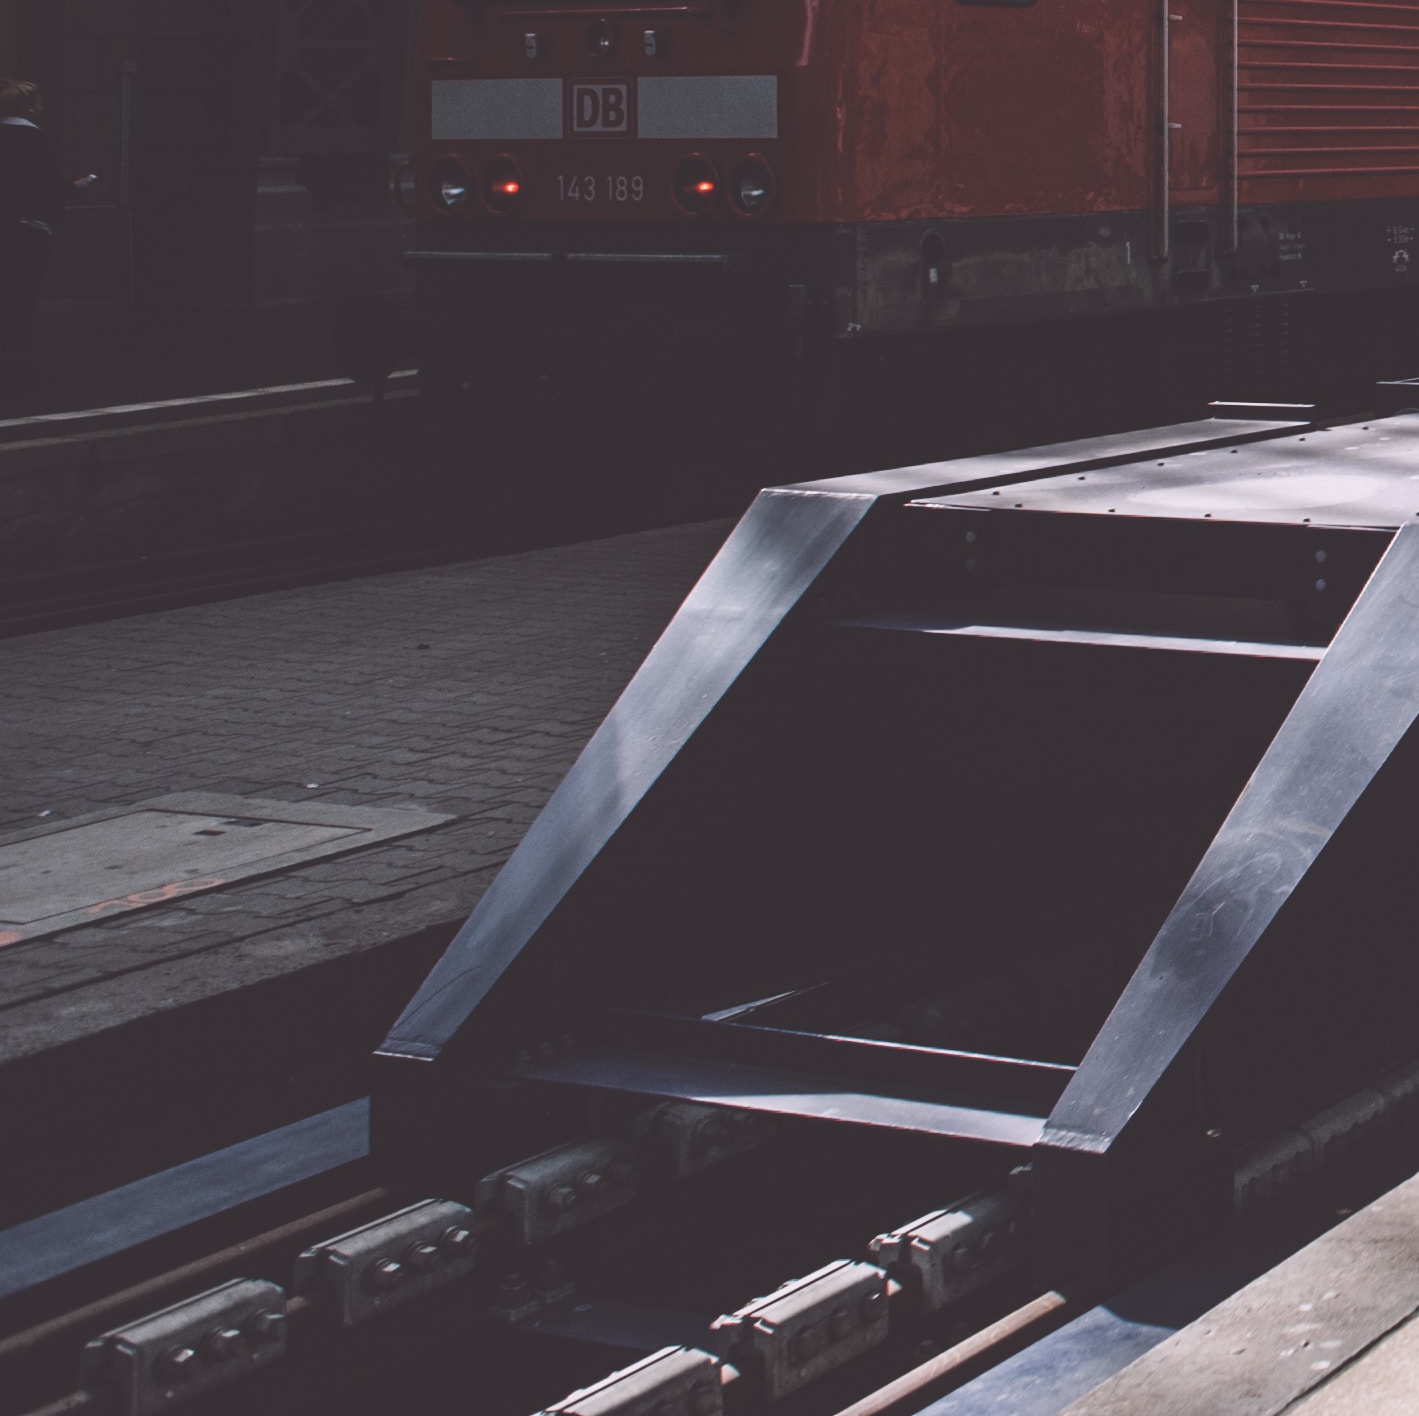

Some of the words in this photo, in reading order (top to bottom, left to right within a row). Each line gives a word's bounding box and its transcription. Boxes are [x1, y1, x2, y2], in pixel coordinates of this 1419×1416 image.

[576, 87, 626, 129] DB
[557, 175, 596, 201] 143
[606, 175, 645, 201] 189
